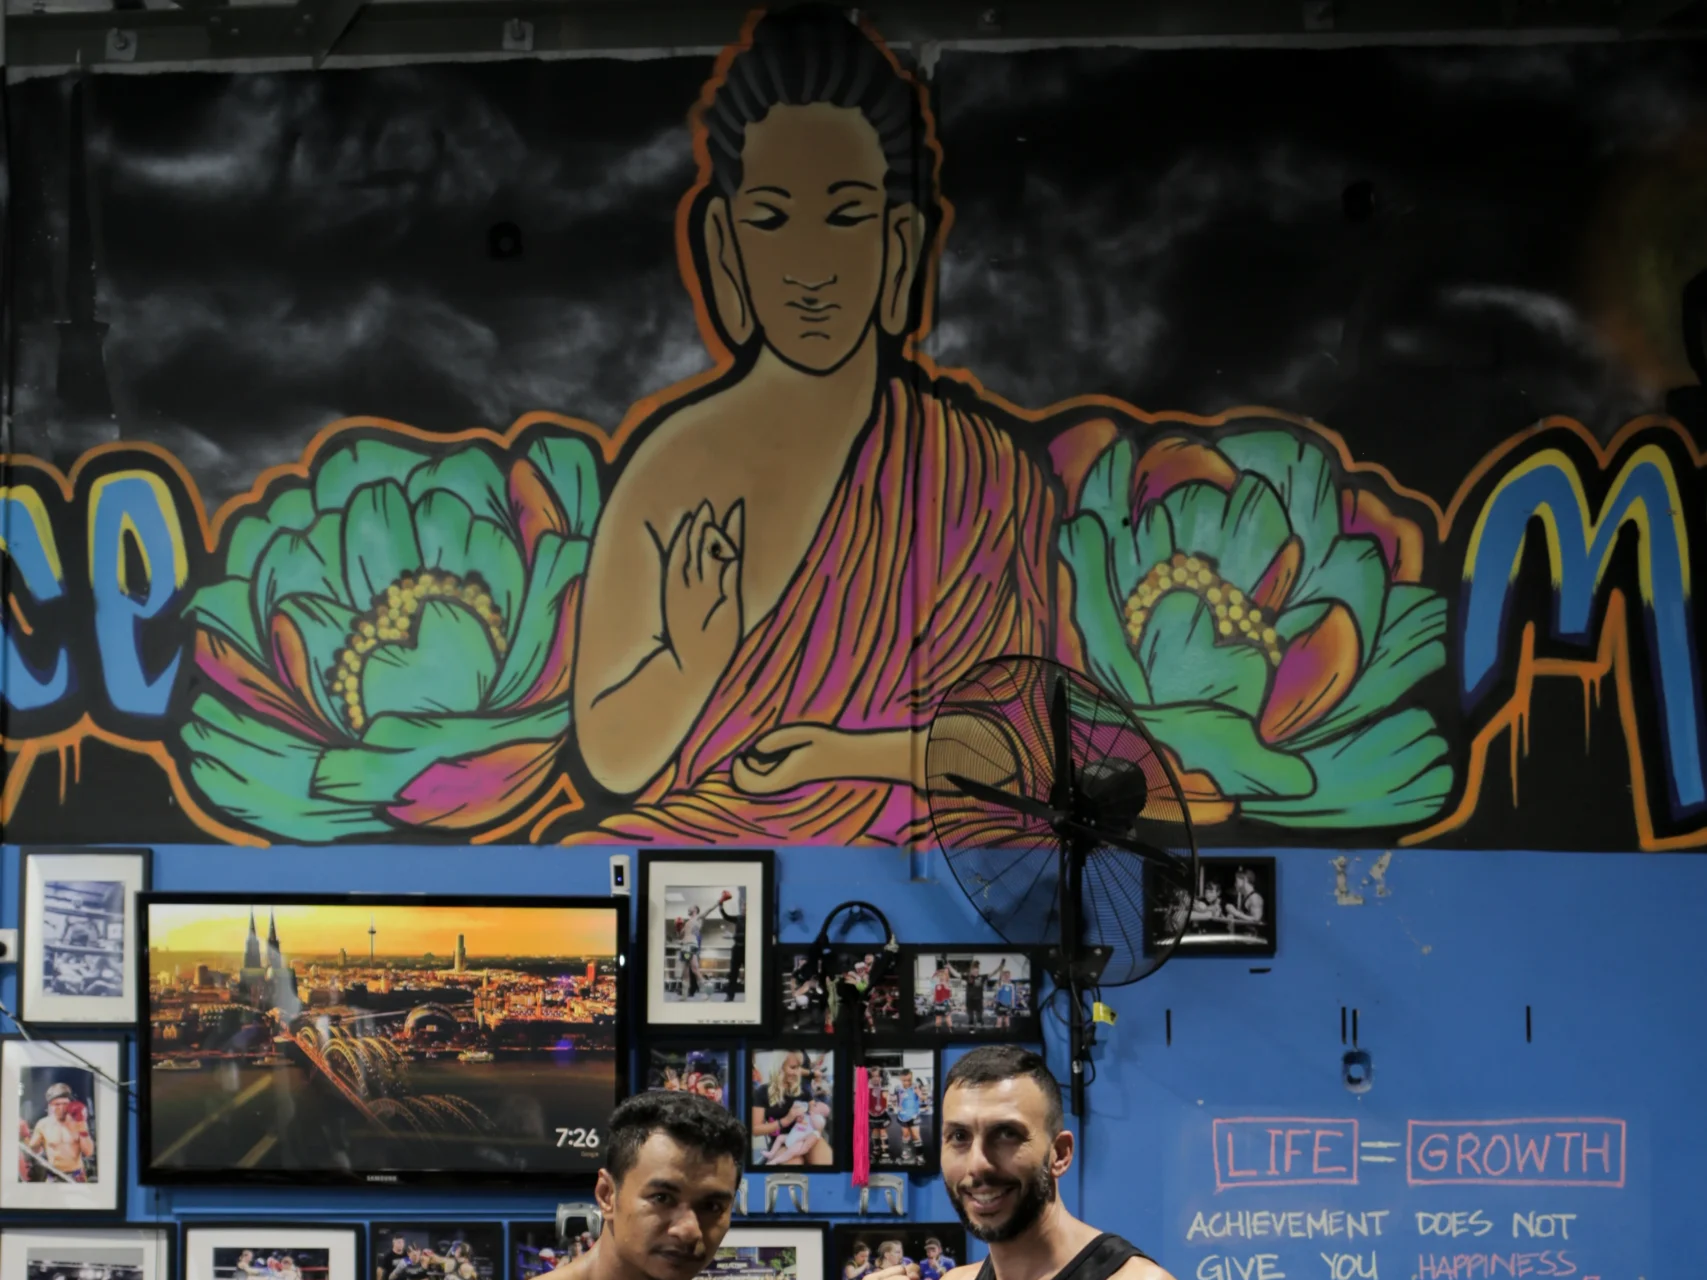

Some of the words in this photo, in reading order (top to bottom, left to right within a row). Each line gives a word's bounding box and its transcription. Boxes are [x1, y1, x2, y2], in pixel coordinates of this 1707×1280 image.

[555, 1127, 600, 1149] 7:26
[1227, 1129, 1347, 1177] LIFE
[1418, 1132, 1610, 1176] GROWTH
[1186, 1209, 1390, 1240] ACHIEVEMENT
[1416, 1210, 1493, 1238] DOES
[1512, 1210, 1577, 1240] NOT
[1418, 1250, 1577, 1280] HAPPINESS
